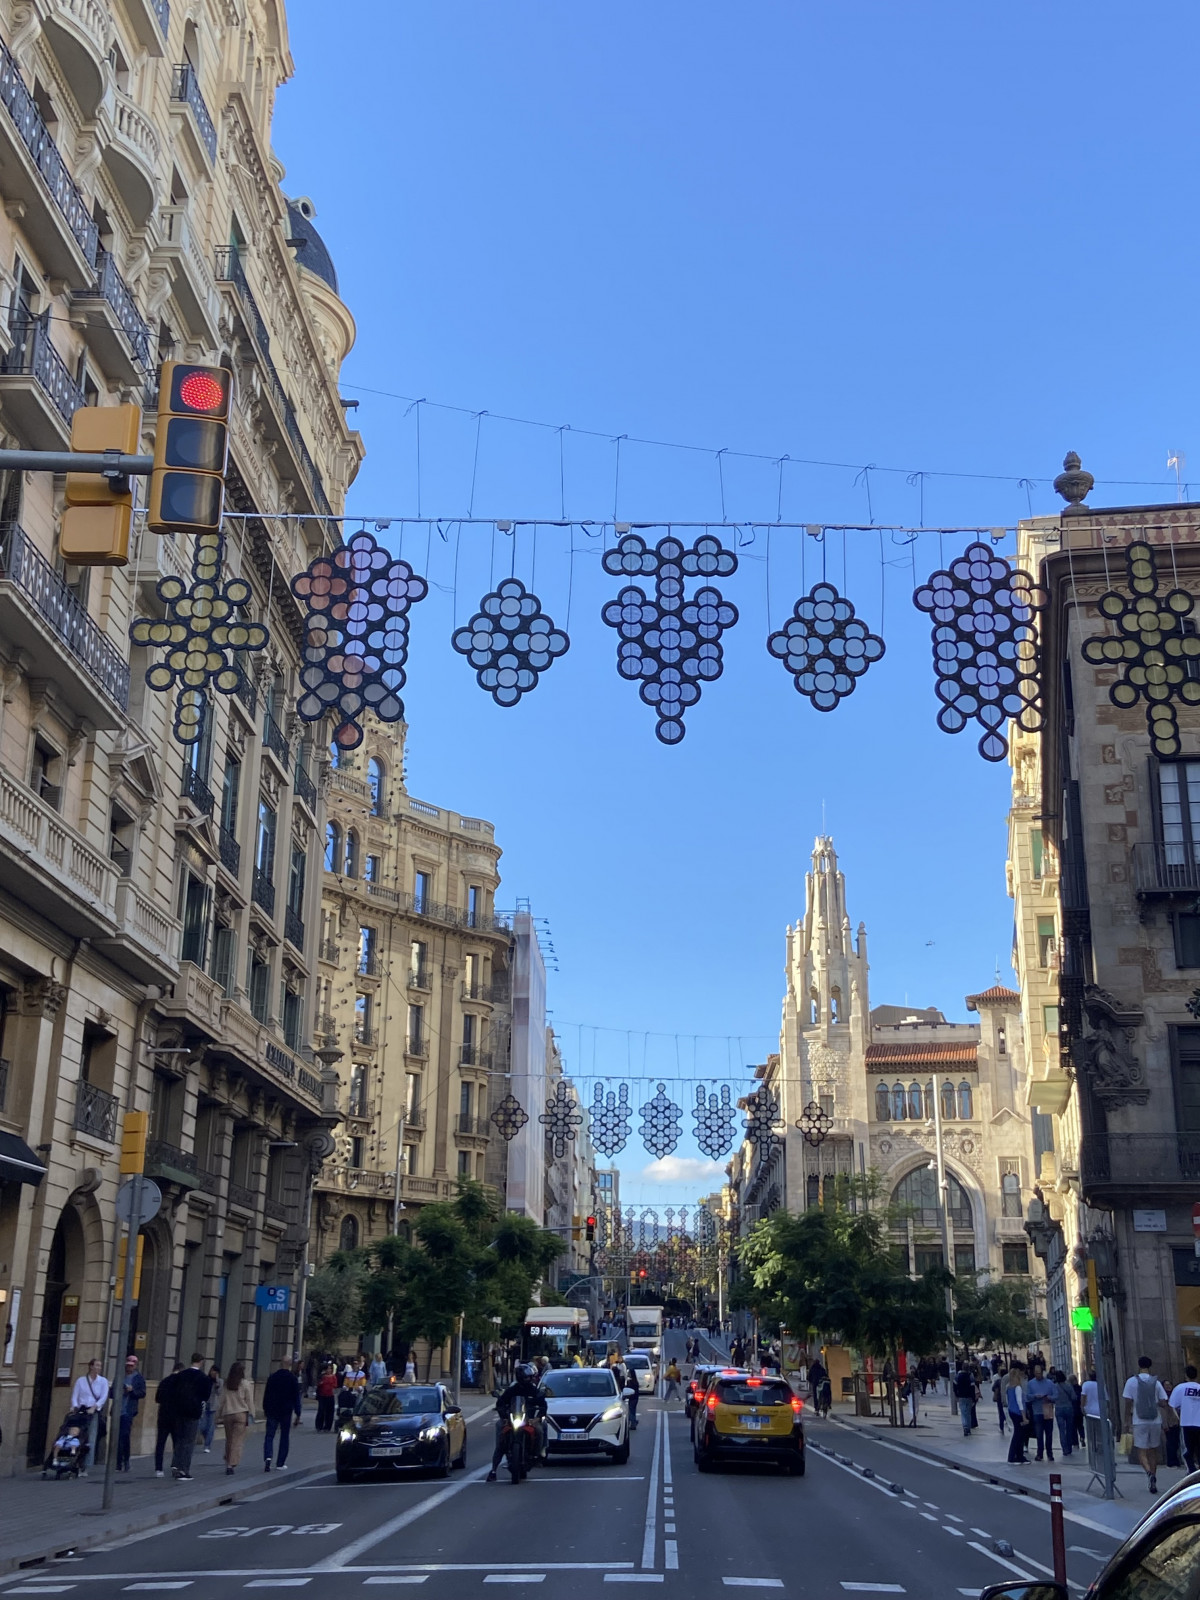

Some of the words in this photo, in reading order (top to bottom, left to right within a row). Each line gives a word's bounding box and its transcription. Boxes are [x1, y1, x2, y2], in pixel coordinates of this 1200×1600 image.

[530, 1326, 540, 1335] 59
[542, 1326, 568, 1336] Poblenou
[197, 1523, 343, 1538] BUS
